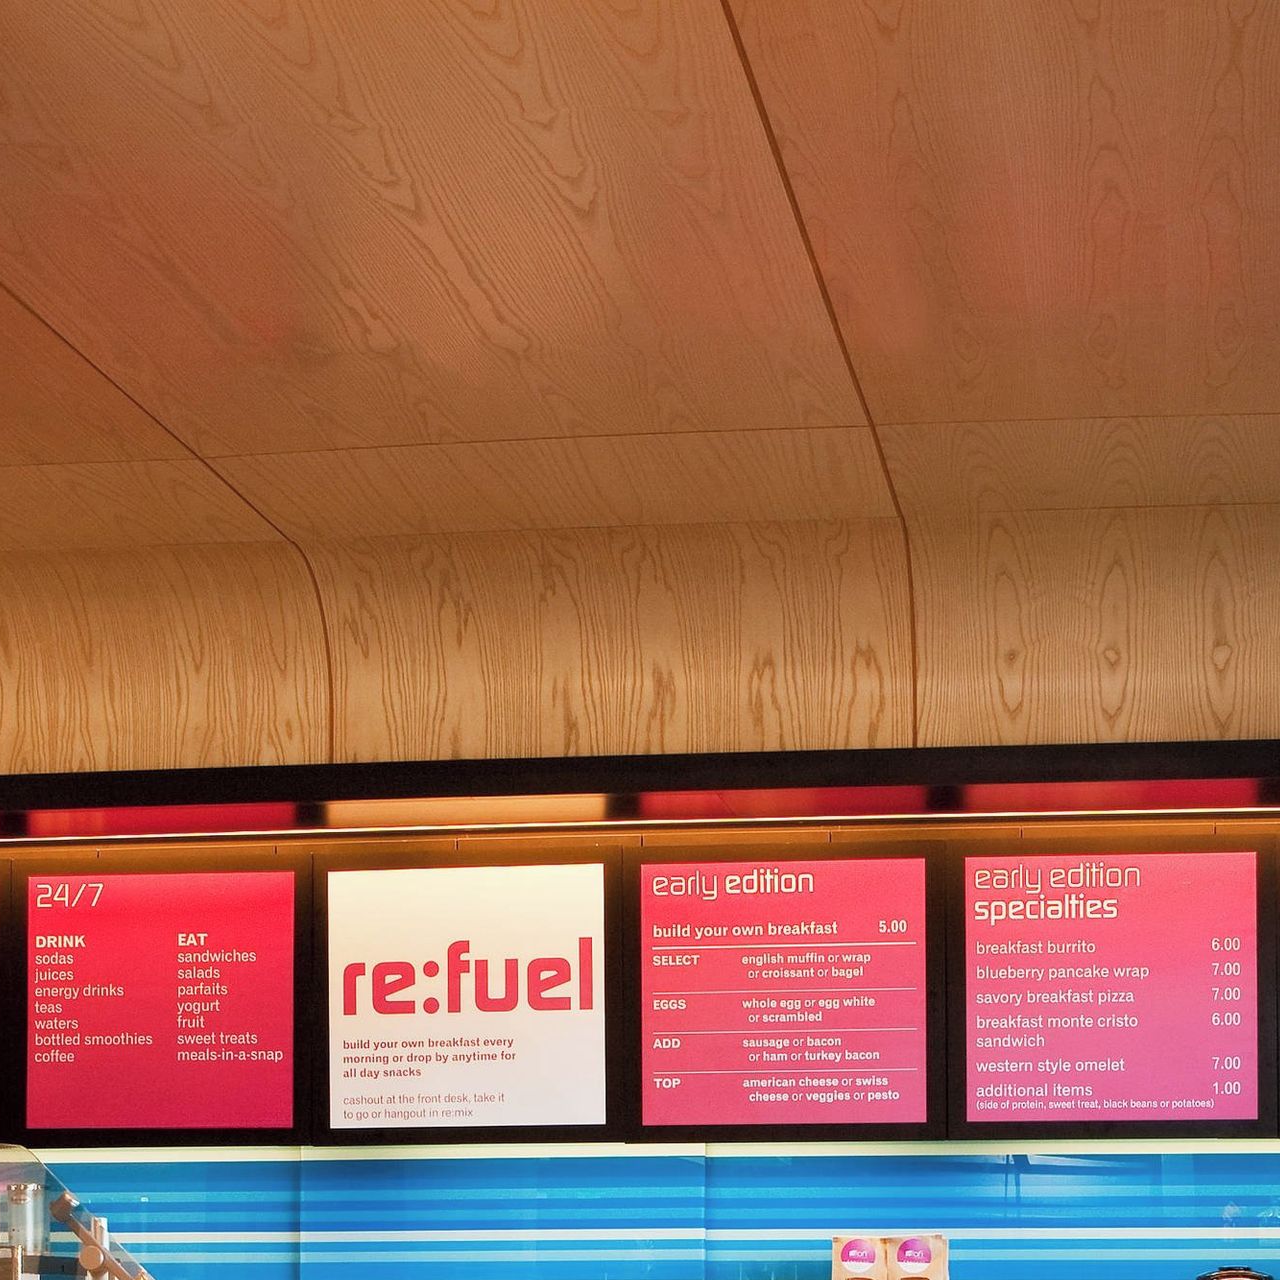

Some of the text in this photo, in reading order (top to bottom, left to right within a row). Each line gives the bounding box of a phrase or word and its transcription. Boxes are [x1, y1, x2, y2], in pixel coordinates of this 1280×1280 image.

[653, 868, 813, 900] early edition
[976, 862, 1140, 893] early edition
[37, 883, 103, 907] 24/7
[975, 893, 1117, 925] specialties
[654, 921, 837, 939] build your own breakfast
[879, 920, 906, 932] 5.00
[36, 936, 85, 948] DRINK
[178, 934, 208, 946] EAT
[1212, 938, 1240, 950] 6.00
[977, 940, 1095, 954] breakfast burrito
[35, 952, 73, 964] sodas
[178, 949, 256, 962] sandwiches
[653, 955, 700, 966] SELECT
[742, 953, 784, 966] english
[788, 952, 824, 963] muffin
[842, 954, 871, 964] wrap
[178, 966, 220, 979] salads
[977, 965, 1149, 981] blueberry pancake wrap
[1212, 962, 1240, 975] 7.00
[35, 970, 73, 983] juices
[343, 937, 593, 1015] re:fuel
[35, 984, 124, 999] energy drinks
[178, 982, 227, 997] parfaits
[1212, 987, 1240, 1000] 7.00
[743, 996, 875, 1010] whole egg or egg white
[976, 989, 1134, 1006] savory breakfast pizza
[35, 1001, 62, 1013] teas
[177, 1000, 220, 1014] yogurt
[654, 999, 686, 1010] EGGS
[35, 1017, 78, 1029] waters
[177, 1015, 204, 1028] fruit
[977, 1014, 1138, 1028] breakfast monte cristo
[1212, 1012, 1240, 1025] 6.00
[36, 1033, 152, 1045] bottled smoothies
[178, 1032, 257, 1044] sweet treats
[344, 1038, 513, 1051] build your own breakfast every
[653, 1039, 680, 1048] ADD
[35, 1050, 74, 1062] coffee
[178, 1048, 283, 1062] meals-in-a-snap
[976, 1058, 1124, 1074] western style omelet
[1212, 1057, 1240, 1069] 7.00
[343, 1067, 421, 1079] all day snacks
[654, 1078, 680, 1088] TOP
[1213, 1082, 1240, 1094] 1.00
[976, 1084, 1092, 1097] additional items
